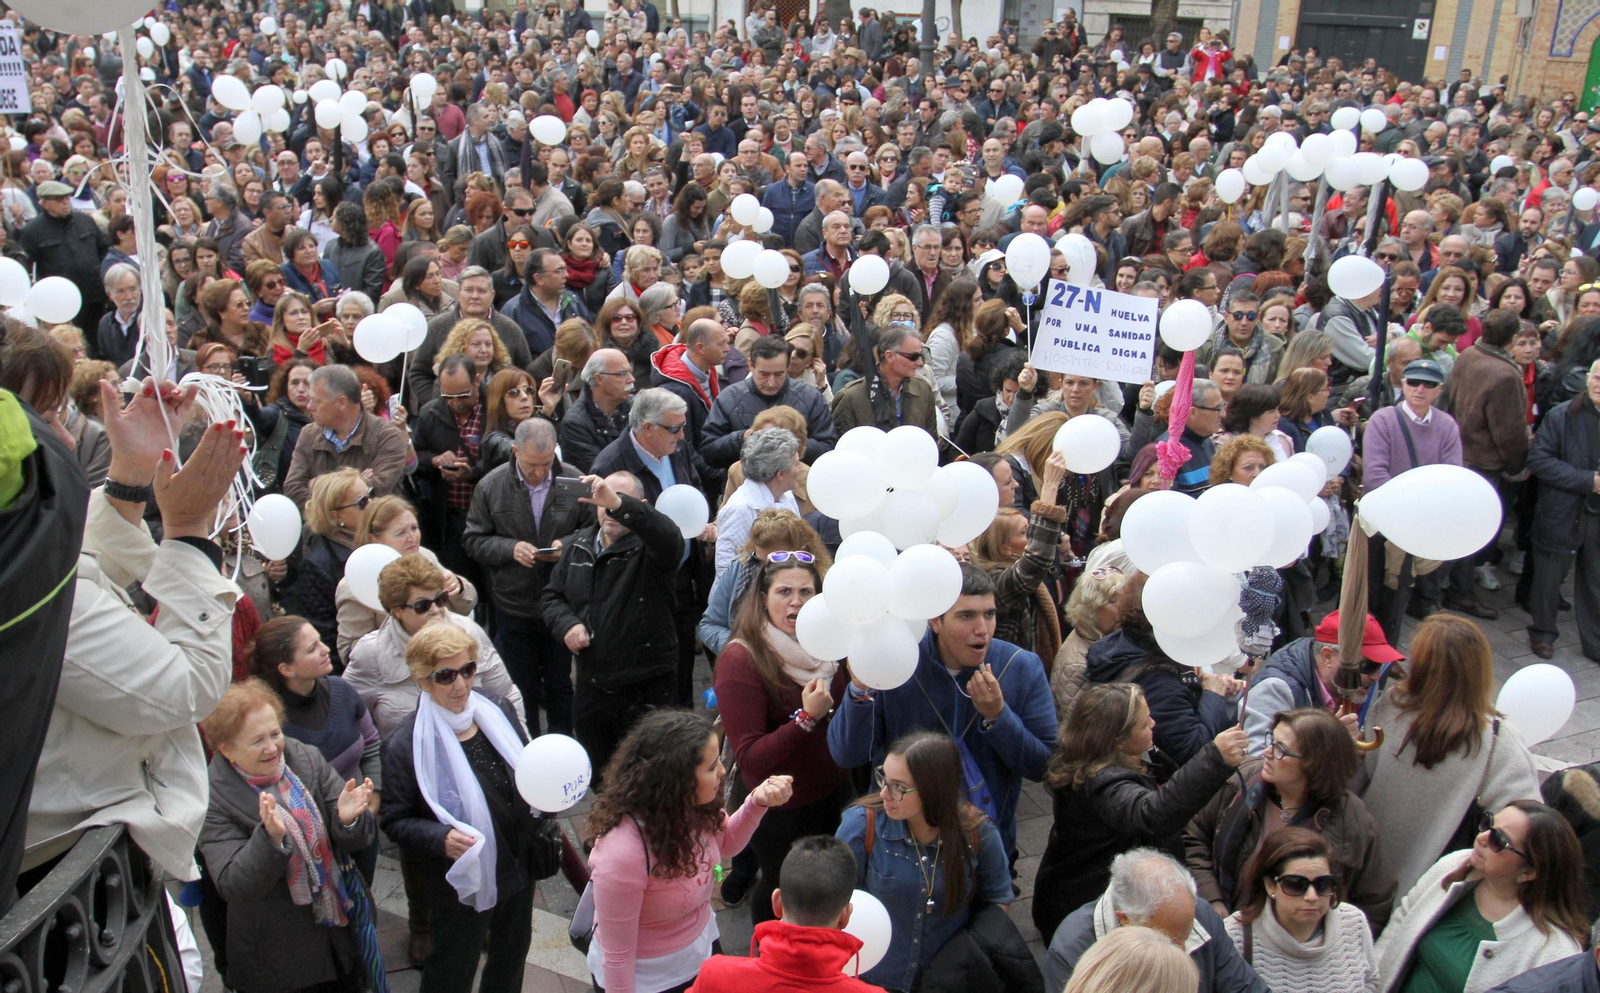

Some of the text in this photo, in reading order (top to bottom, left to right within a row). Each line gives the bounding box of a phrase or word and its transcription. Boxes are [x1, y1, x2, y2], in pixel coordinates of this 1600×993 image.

[1050, 282, 1102, 314] 27-N
[1111, 309, 1150, 322] HUELVA
[1045, 317, 1152, 341] POR UNA SANIDAD
[1053, 335, 1147, 360] PÚBLICA DIGNA
[562, 775, 584, 796] POR
